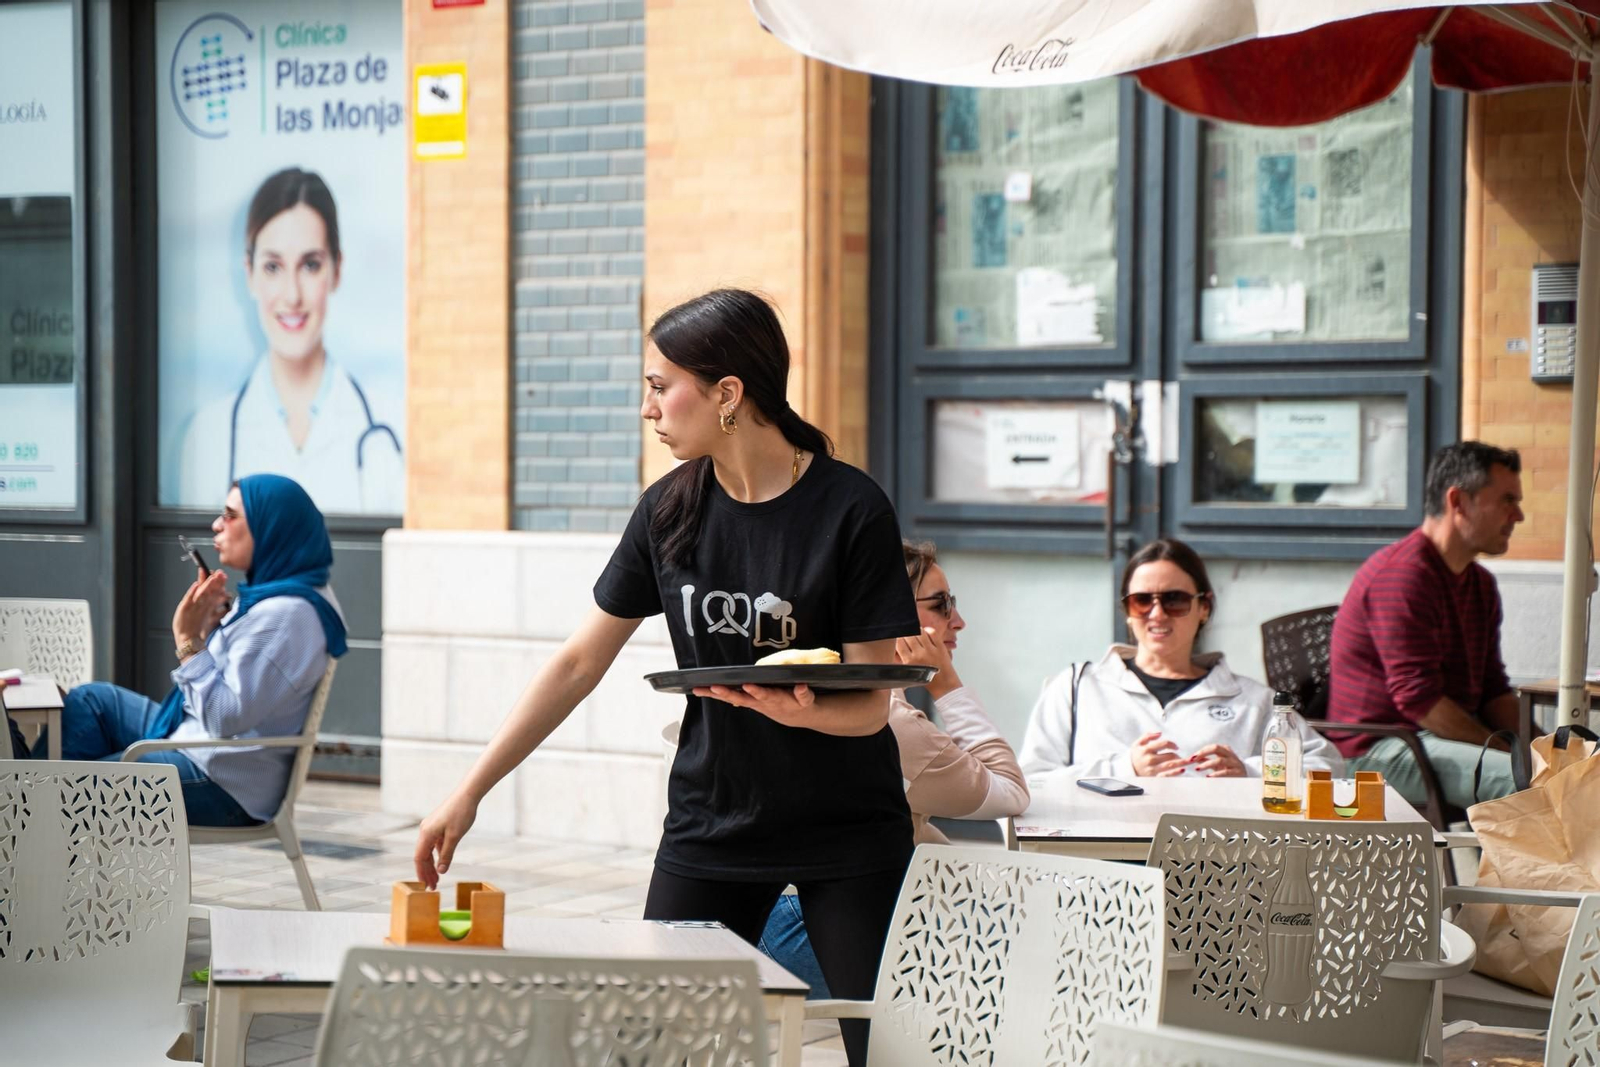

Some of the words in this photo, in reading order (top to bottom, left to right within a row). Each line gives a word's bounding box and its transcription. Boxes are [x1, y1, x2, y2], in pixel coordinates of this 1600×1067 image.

[275, 21, 347, 49] Clínica
[276, 57, 347, 88] Plaza
[354, 51, 387, 82] de
[276, 104, 312, 133] las
[323, 97, 403, 135] Monja
[11, 307, 74, 336] Clínic
[11, 347, 73, 380] Plaz
